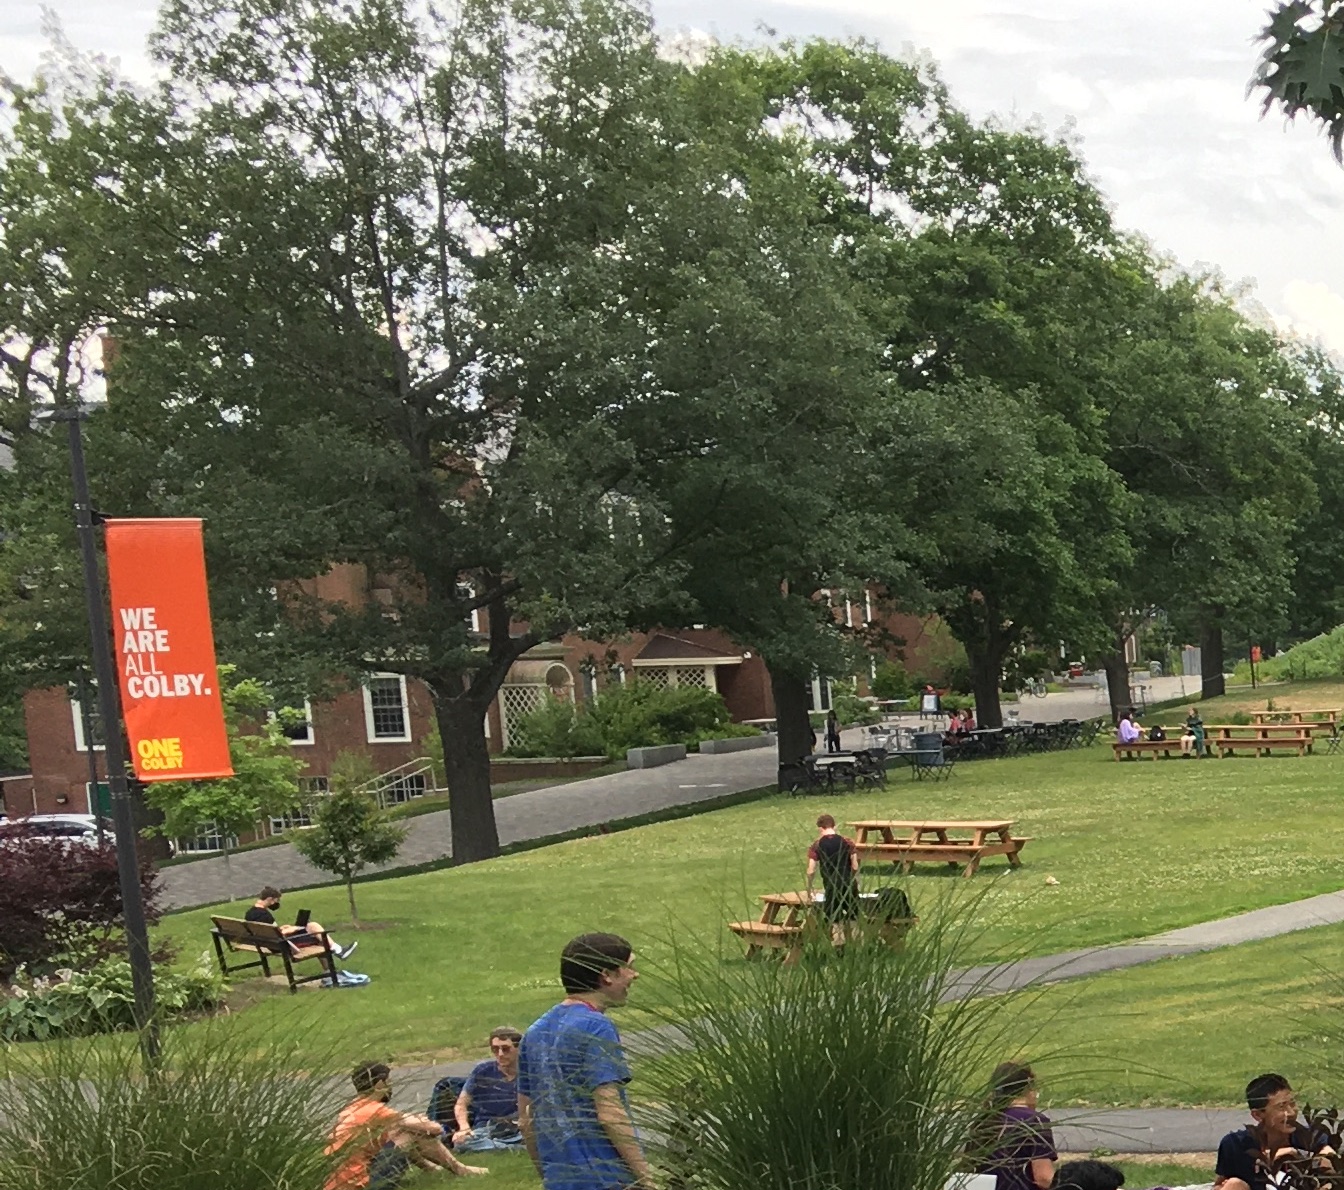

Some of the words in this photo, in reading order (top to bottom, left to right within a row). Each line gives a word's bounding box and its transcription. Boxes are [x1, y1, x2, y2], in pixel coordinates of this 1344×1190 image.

[120, 607, 157, 630] WE
[123, 630, 170, 653] ARE
[125, 653, 163, 676] ALL
[127, 674, 211, 699] COLBY.
[137, 738, 183, 759] ONE
[140, 757, 183, 770] COLBY
